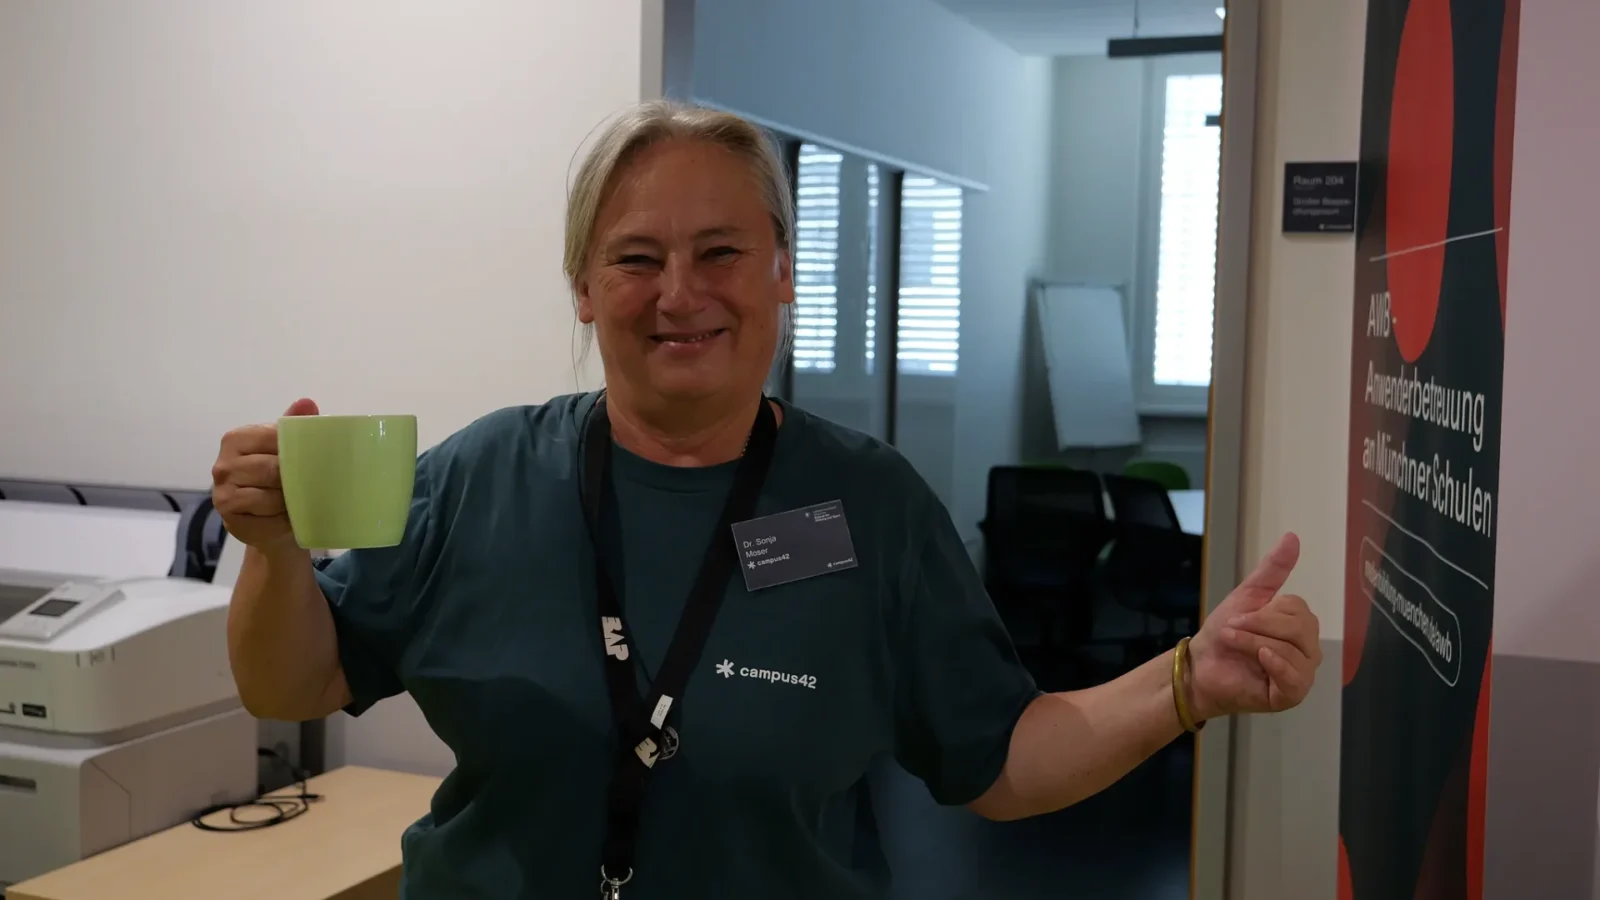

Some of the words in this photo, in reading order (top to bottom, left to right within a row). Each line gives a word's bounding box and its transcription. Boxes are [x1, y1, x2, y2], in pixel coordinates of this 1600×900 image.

[1367, 292, 1390, 337] AWB
[1365, 360, 1485, 452] Anwenderbetreuung
[1363, 436, 1375, 472] an
[1375, 431, 1430, 502] Münchner
[1431, 453, 1492, 538] Schulen
[743, 541, 755, 549] Dr.
[756, 536, 777, 546] Sonja
[745, 548, 769, 558] Moser
[757, 553, 790, 566] campus42
[740, 666, 817, 690] campus42
